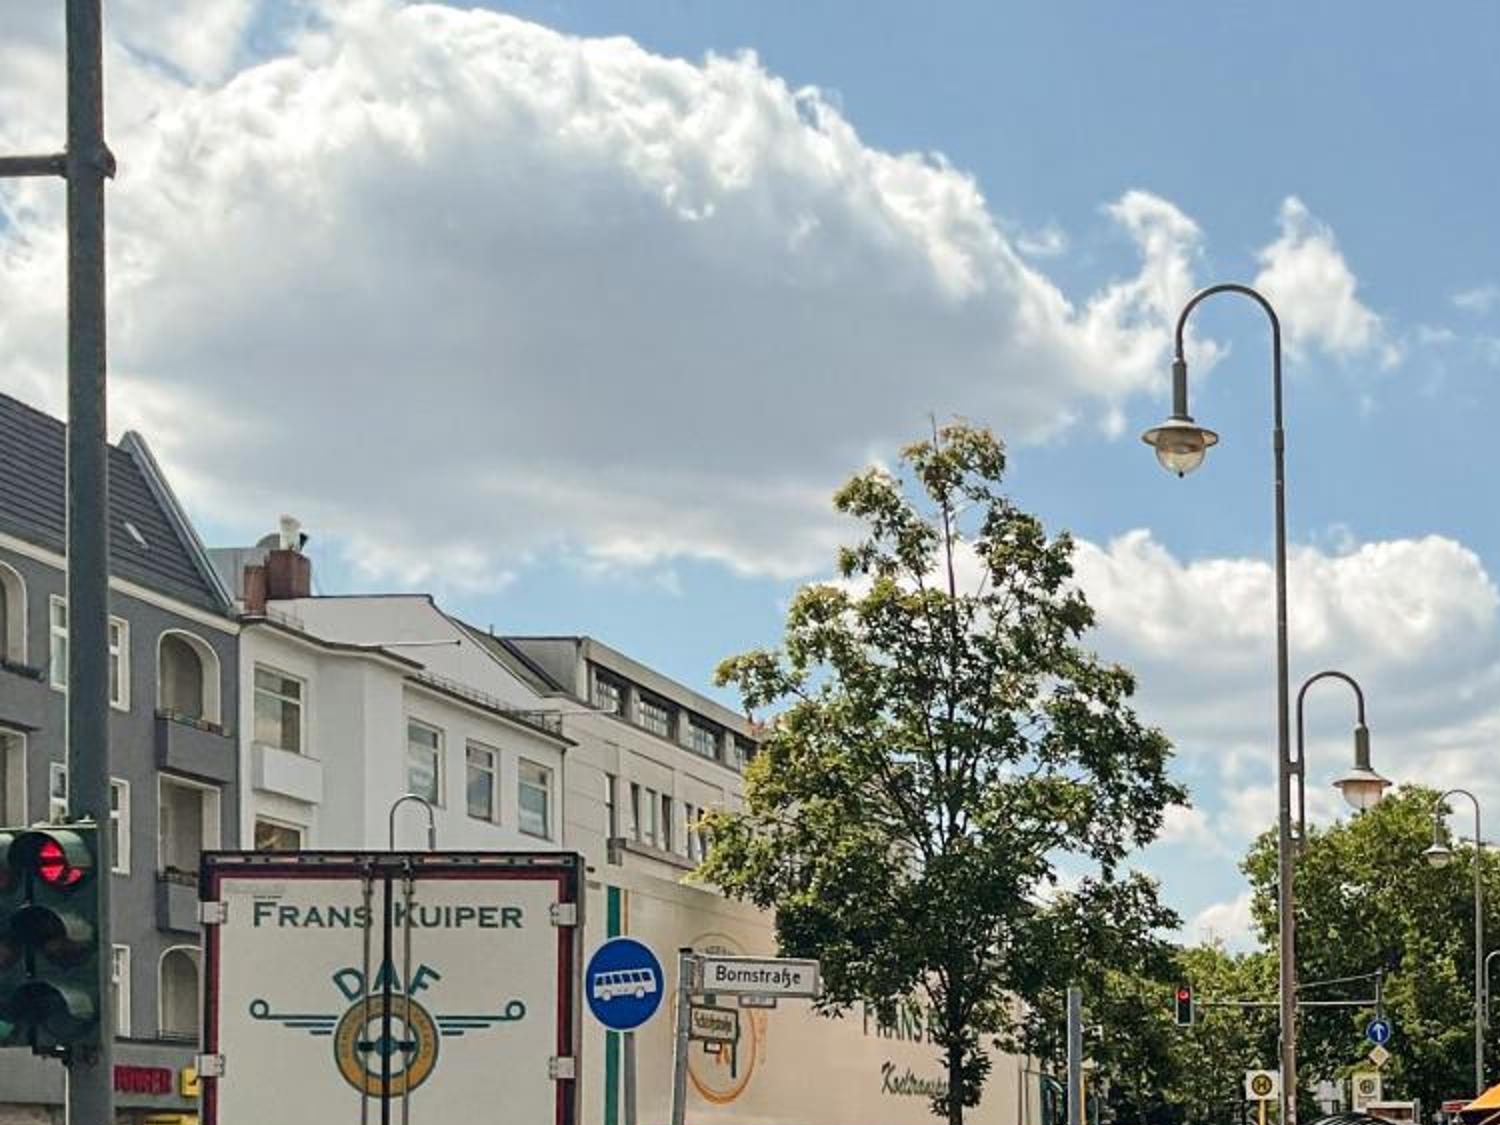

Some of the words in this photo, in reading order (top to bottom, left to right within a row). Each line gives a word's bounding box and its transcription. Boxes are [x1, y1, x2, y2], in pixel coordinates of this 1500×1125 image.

[253, 901, 372, 928] FRANS
[395, 902, 522, 928] KUIPER
[332, 957, 441, 1002] DAF
[715, 965, 801, 987] Bornstraße
